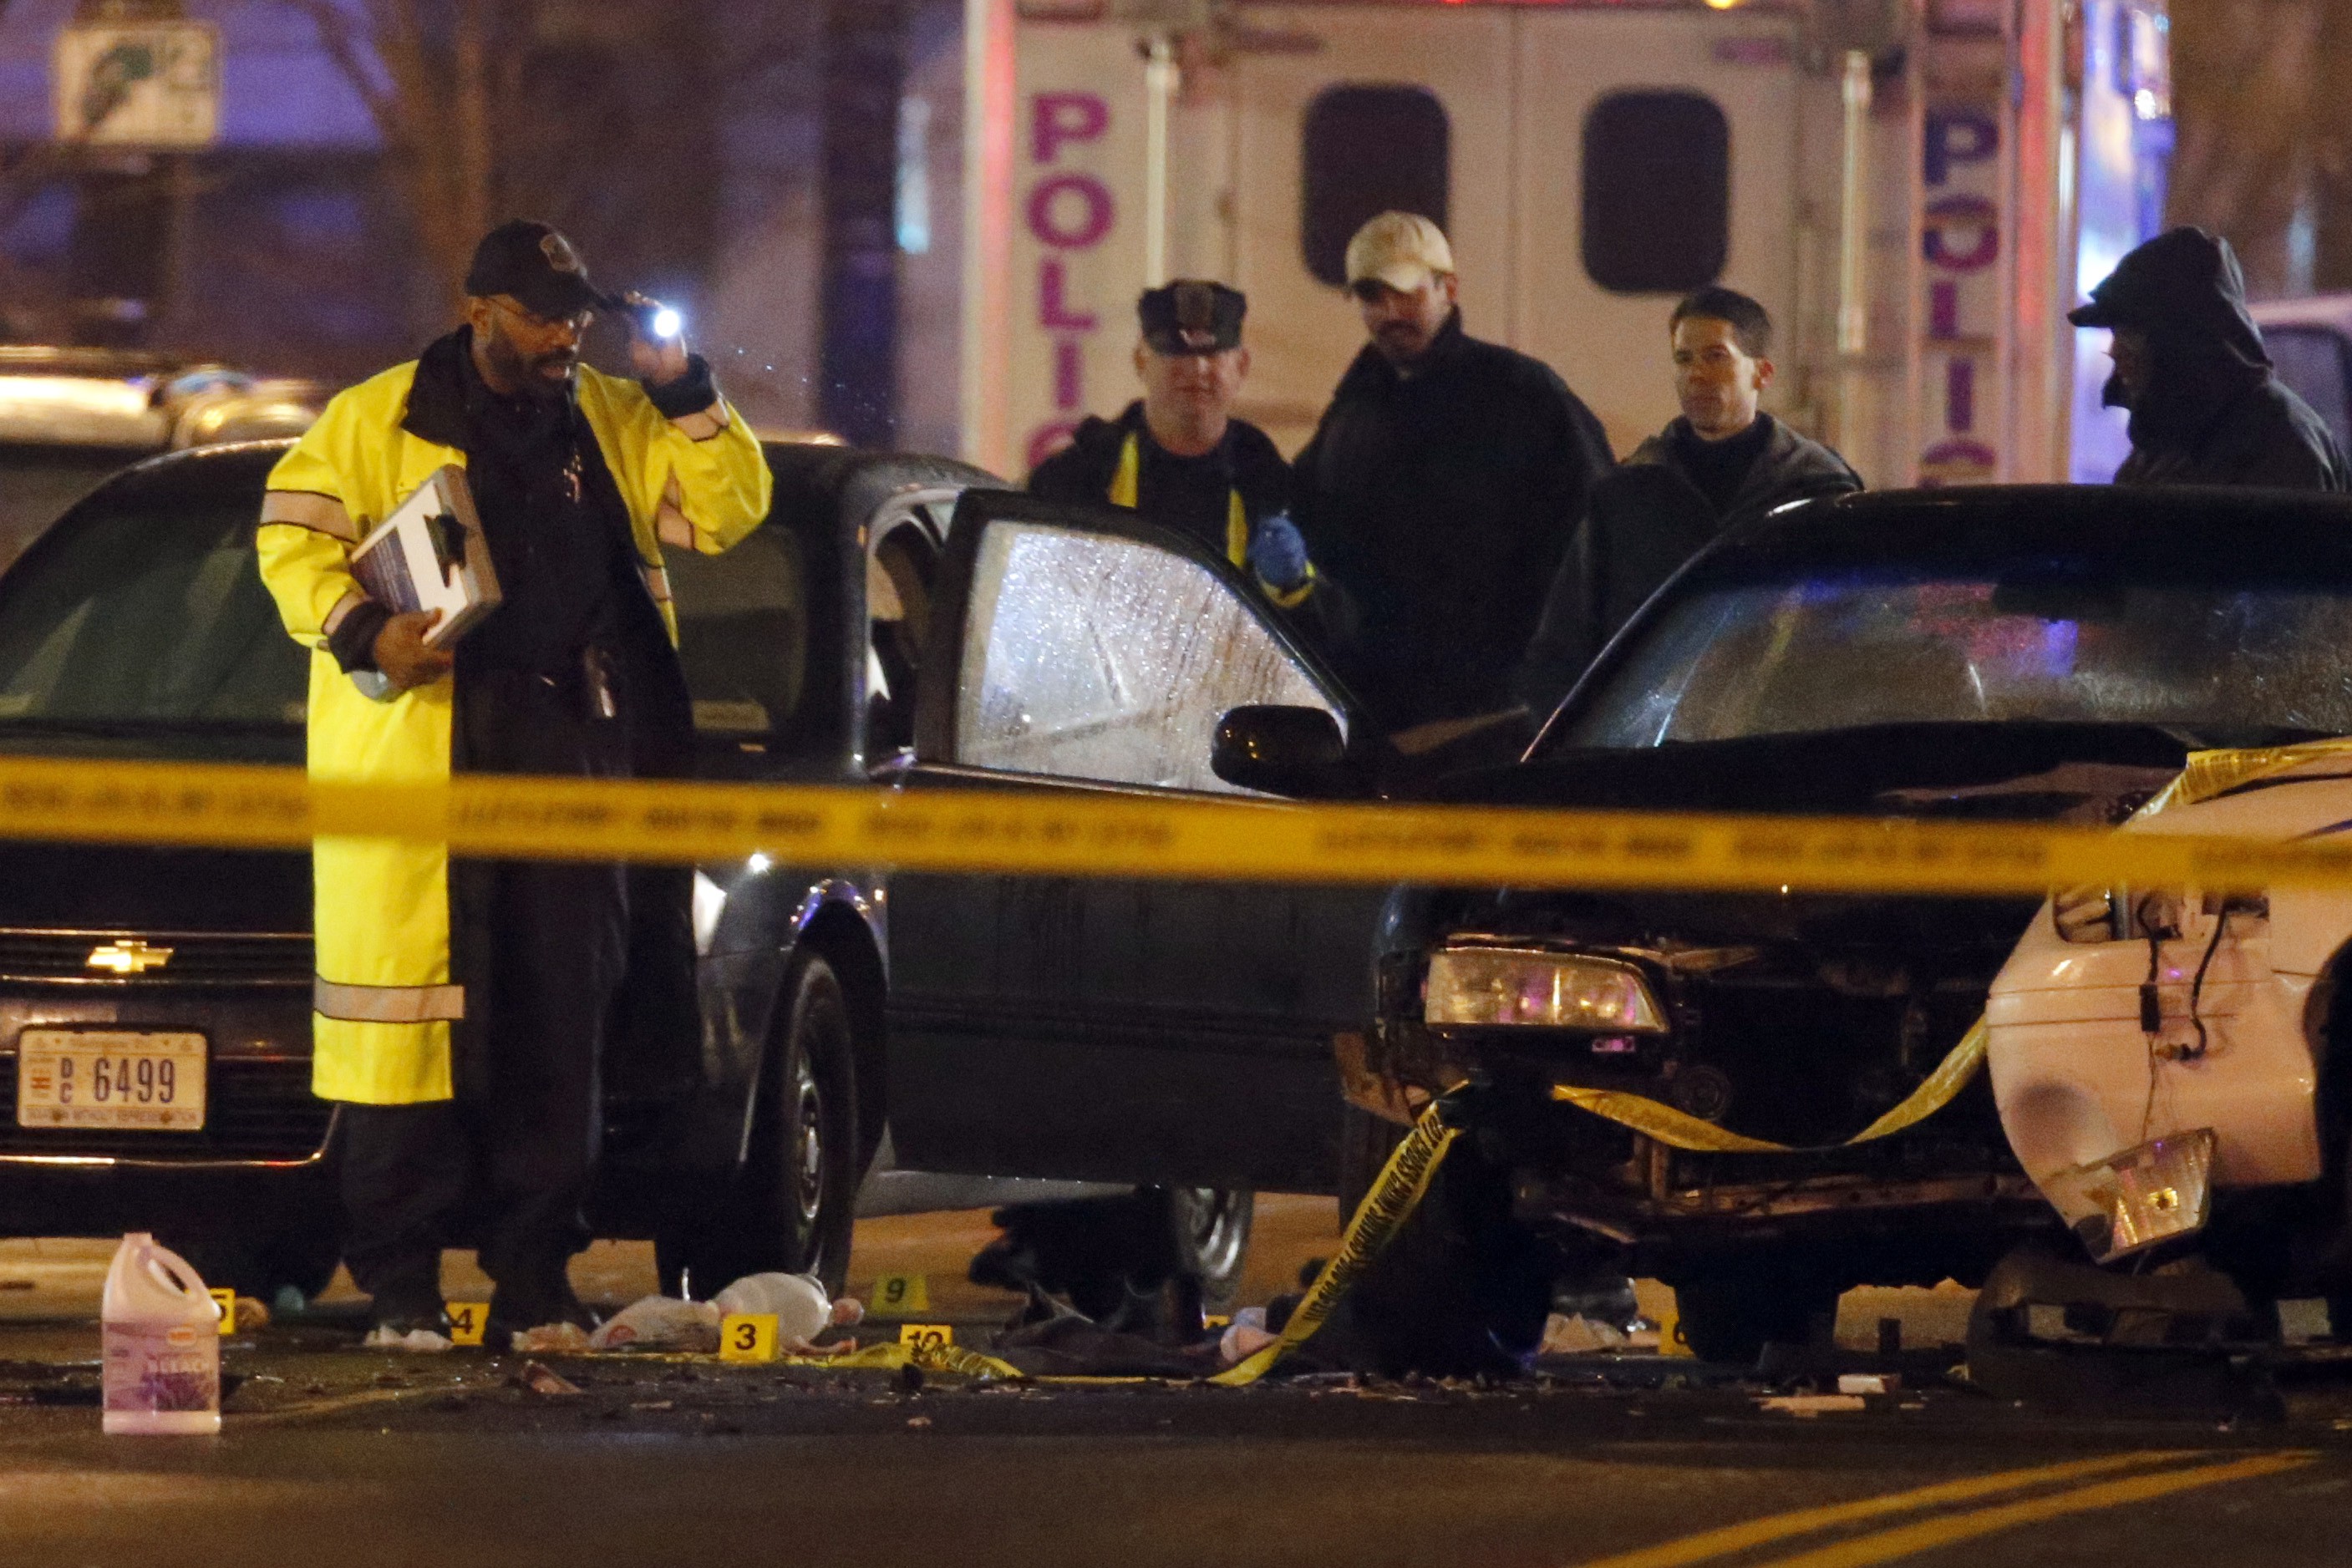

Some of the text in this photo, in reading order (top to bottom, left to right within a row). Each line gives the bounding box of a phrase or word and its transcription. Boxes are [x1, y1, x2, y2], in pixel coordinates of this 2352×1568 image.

[94, 1057, 175, 1103] 6499
[886, 1278, 905, 1302] 9
[451, 1308, 473, 1335] 4
[735, 1324, 756, 1350] 3
